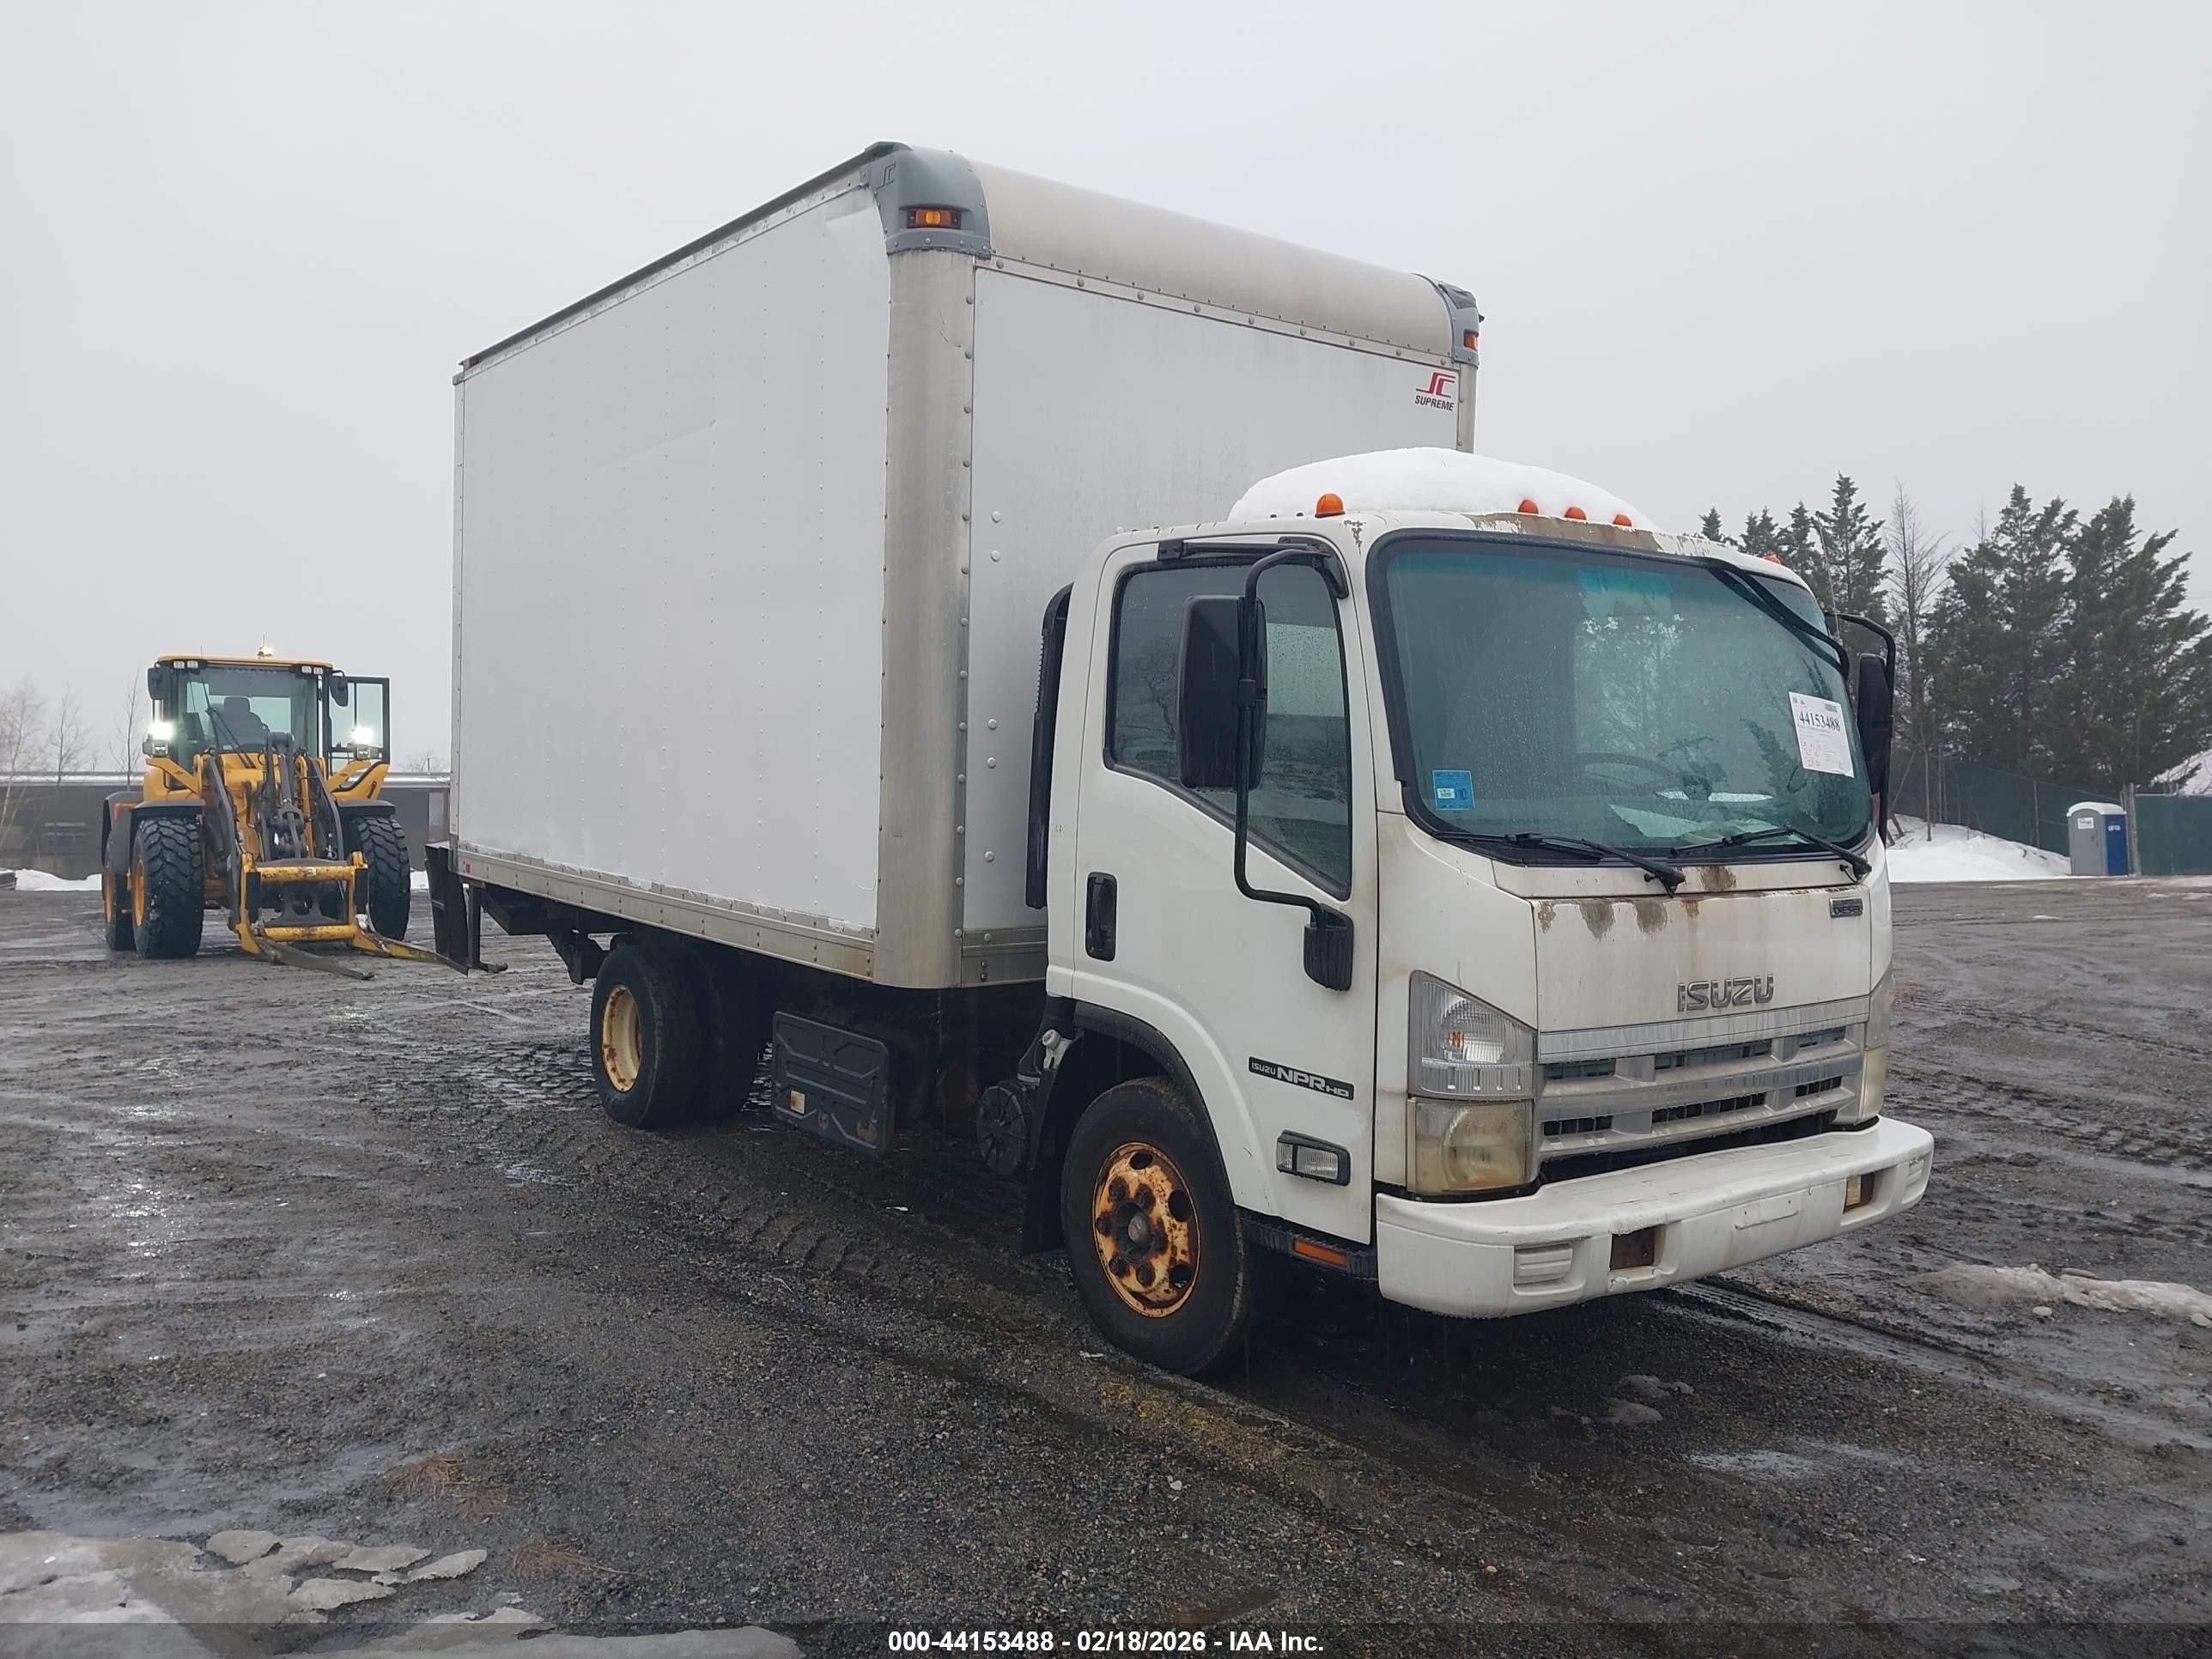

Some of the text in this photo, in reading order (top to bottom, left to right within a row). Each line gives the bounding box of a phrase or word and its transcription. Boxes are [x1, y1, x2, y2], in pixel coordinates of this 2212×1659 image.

[1414, 395, 1455, 412] SUPREME
[1799, 711, 1841, 732] 44153488
[1677, 974, 1774, 1012] ISUZU
[1251, 1060, 1350, 1097] ISUZU NPR HD
